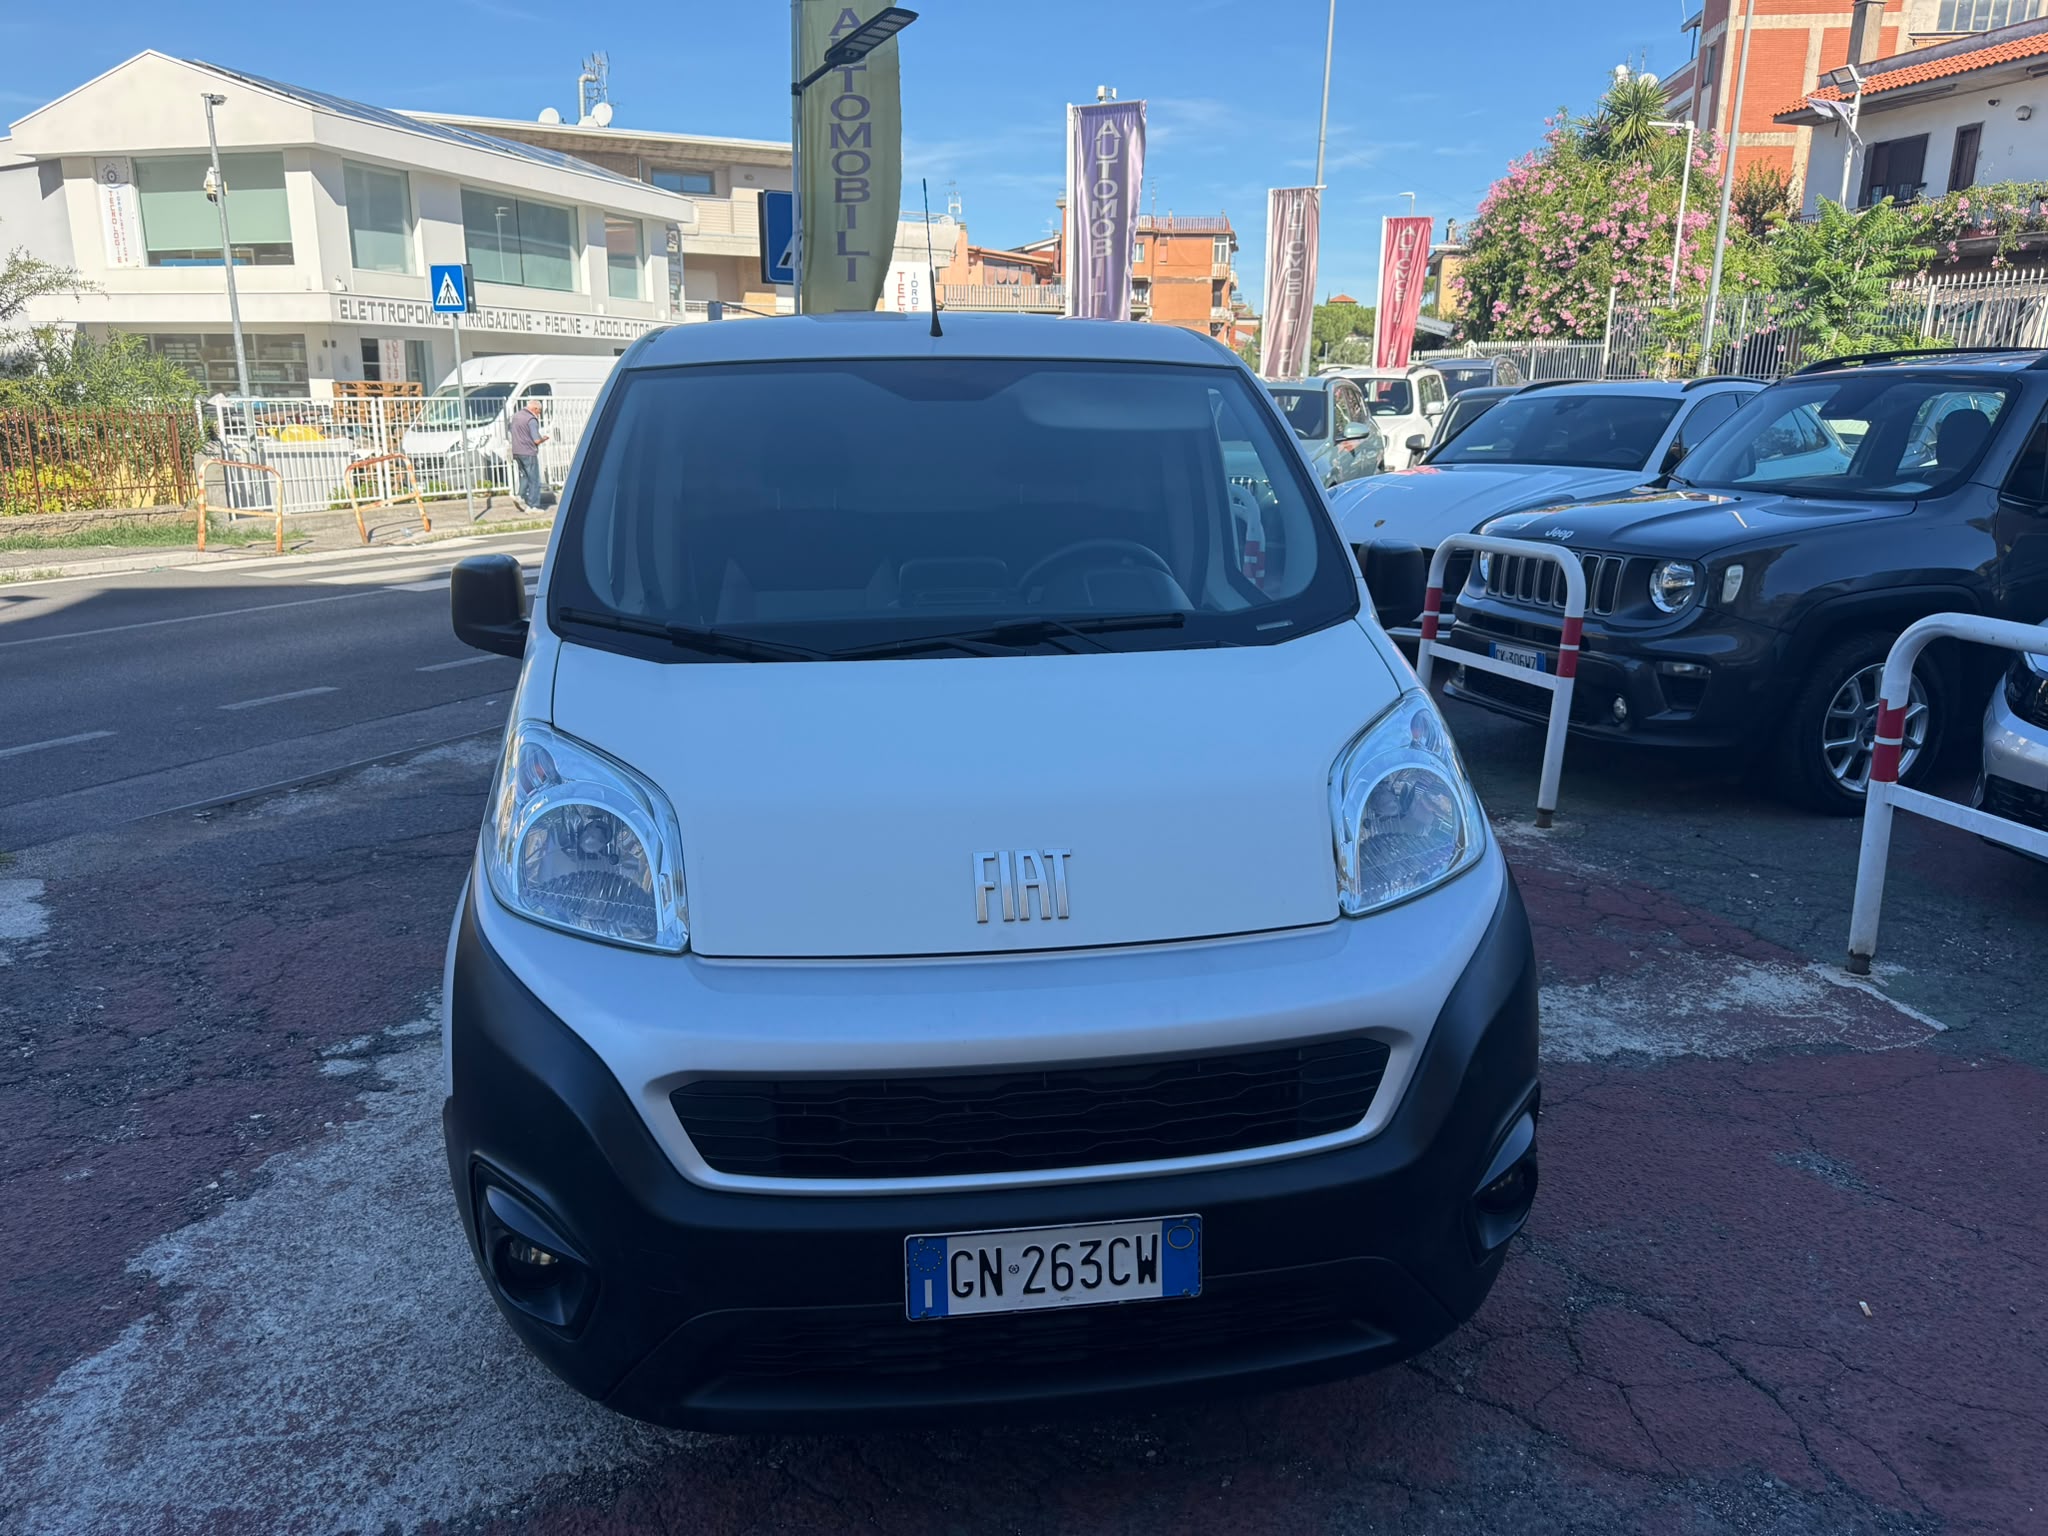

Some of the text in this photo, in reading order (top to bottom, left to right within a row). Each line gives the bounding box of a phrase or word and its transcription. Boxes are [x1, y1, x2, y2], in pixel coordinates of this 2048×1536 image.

[828, 7, 873, 283] ATOMOBILI
[465, 308, 532, 331] IRRIGAZIONE
[545, 315, 581, 334] PISCINE
[1545, 526, 1575, 541] Jeep
[972, 848, 1071, 923] FIAT
[950, 1247, 1004, 1298] GN
[1021, 1233, 1159, 1295] 263CW
